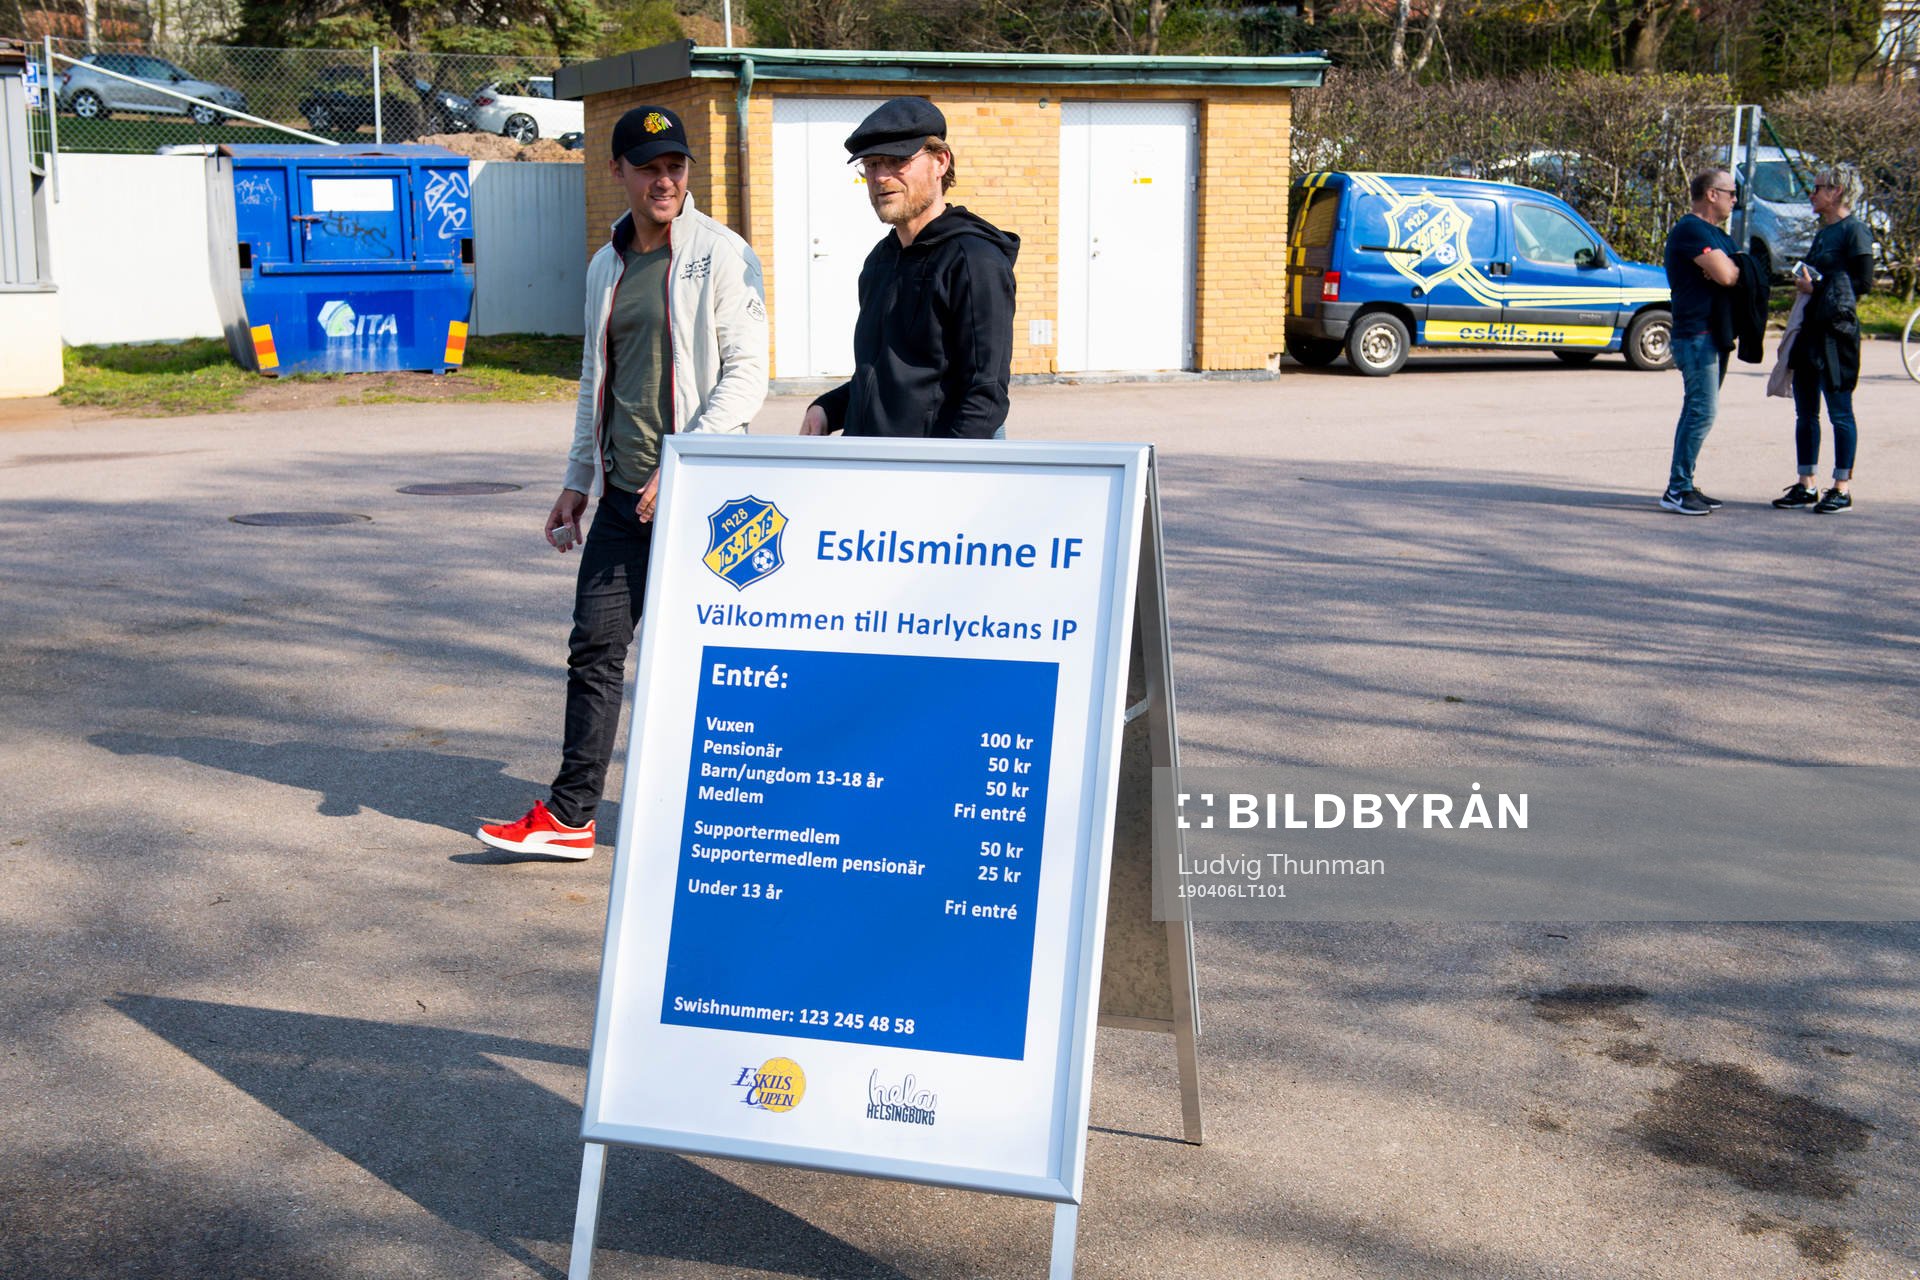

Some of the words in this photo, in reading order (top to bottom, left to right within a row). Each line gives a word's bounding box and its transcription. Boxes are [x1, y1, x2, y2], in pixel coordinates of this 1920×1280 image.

[342, 313, 398, 337] SITA
[1459, 323, 1564, 343] eskils.nu
[722, 508, 749, 533] 1928
[817, 530, 1036, 567] Eskilsminne
[1051, 538, 1082, 568] IF
[697, 605, 844, 630] Välkommen
[855, 611, 887, 632] till
[898, 613, 1041, 641] Harlyckans
[1053, 619, 1077, 640] IP
[712, 664, 787, 688] Entré:
[707, 717, 754, 732] Vuxen
[981, 733, 1011, 748] 100
[1016, 734, 1033, 749] kr
[704, 740, 782, 757] Pensionär
[988, 758, 1008, 772] 50
[1014, 758, 1031, 773] kr
[701, 763, 810, 784] Barn/ungdom
[817, 771, 862, 787] 13-18
[867, 772, 884, 788] år
[986, 782, 1006, 796] 50
[1012, 782, 1029, 797] kr
[699, 786, 763, 803] Medlem
[954, 803, 976, 818] Fri
[981, 807, 1026, 822] entré
[694, 821, 839, 844] Supportermedlem
[981, 842, 1001, 856] 50
[1006, 843, 1023, 858] kr
[692, 844, 837, 868] Supportermedlem
[843, 858, 925, 875] pensionär
[978, 866, 998, 881] 25
[1004, 867, 1021, 882] kr
[689, 879, 737, 896] Under
[742, 884, 760, 898] 13
[766, 884, 782, 899] år
[945, 900, 966, 915] Fri
[972, 904, 1017, 919] entré
[674, 997, 794, 1022] Swishnummer:
[800, 1009, 828, 1025] 123
[834, 1012, 864, 1029] 245
[869, 1016, 889, 1031] 48
[894, 1018, 914, 1034] 58
[866, 1103, 936, 1126] HELSINGBORG
